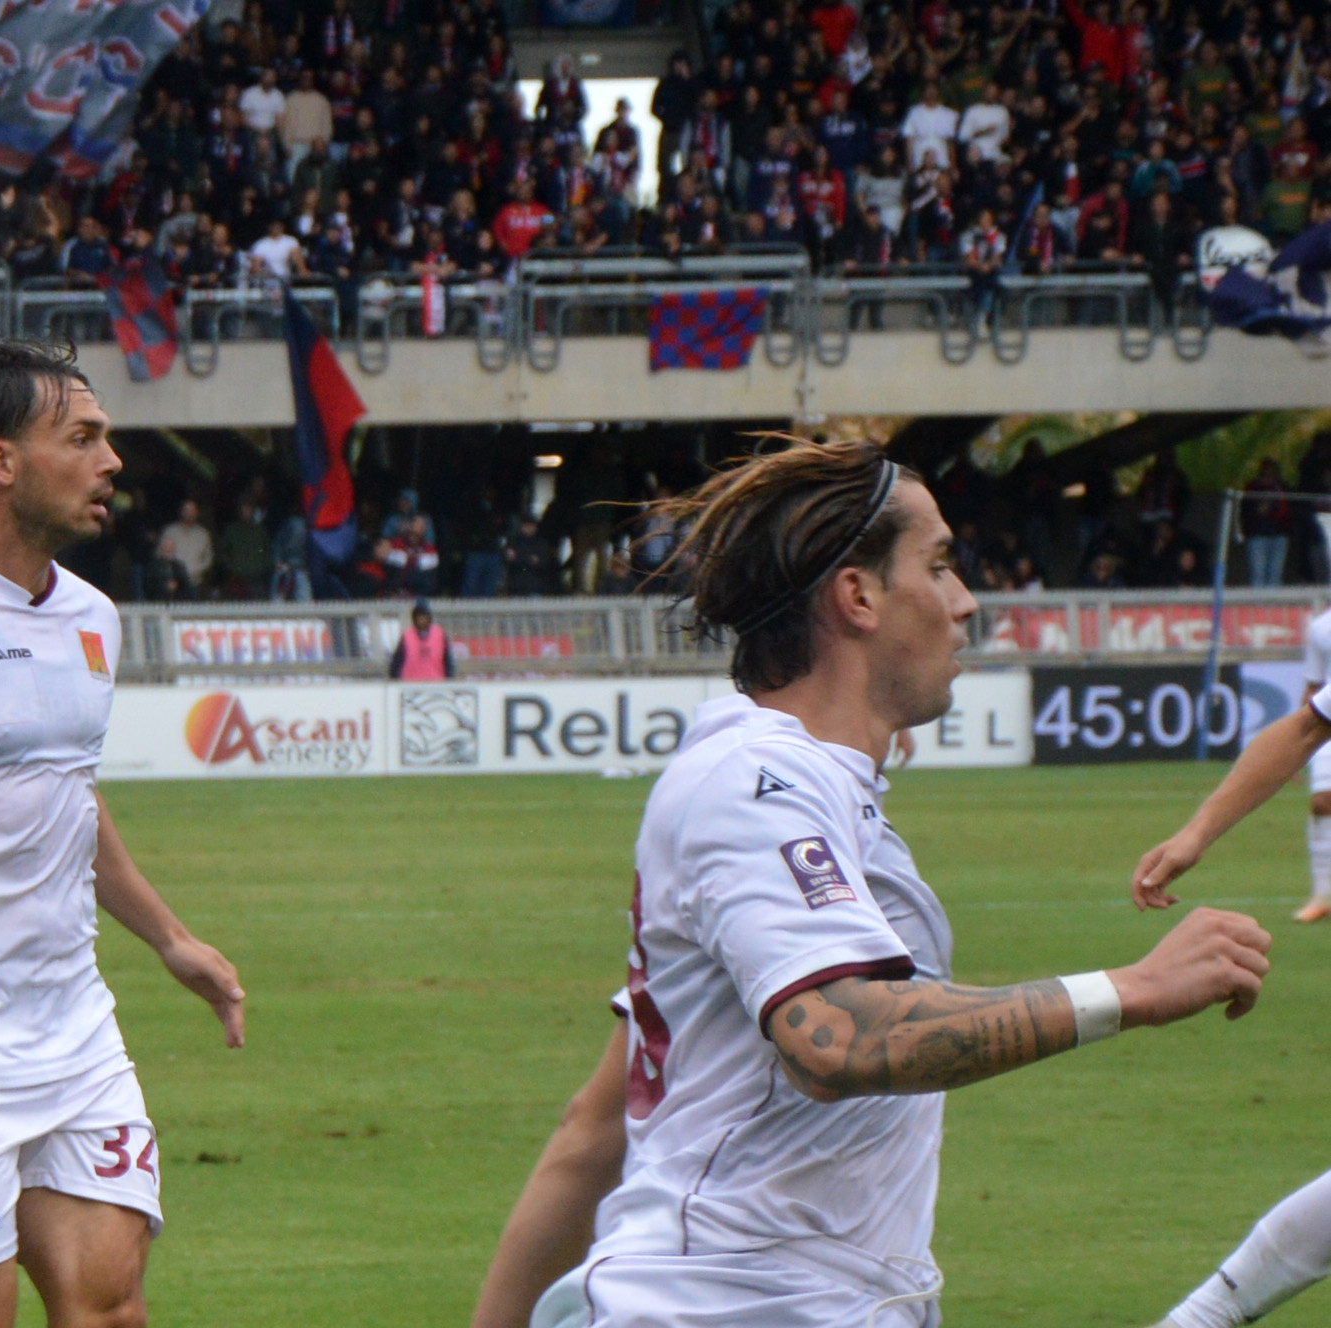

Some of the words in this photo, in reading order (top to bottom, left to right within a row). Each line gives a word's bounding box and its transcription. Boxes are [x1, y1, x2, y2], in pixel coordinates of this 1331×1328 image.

[208, 695, 371, 764] Ascani
[503, 692, 688, 759] Rela
[1035, 682, 1239, 749] 45:00
[267, 741, 372, 770] energy
